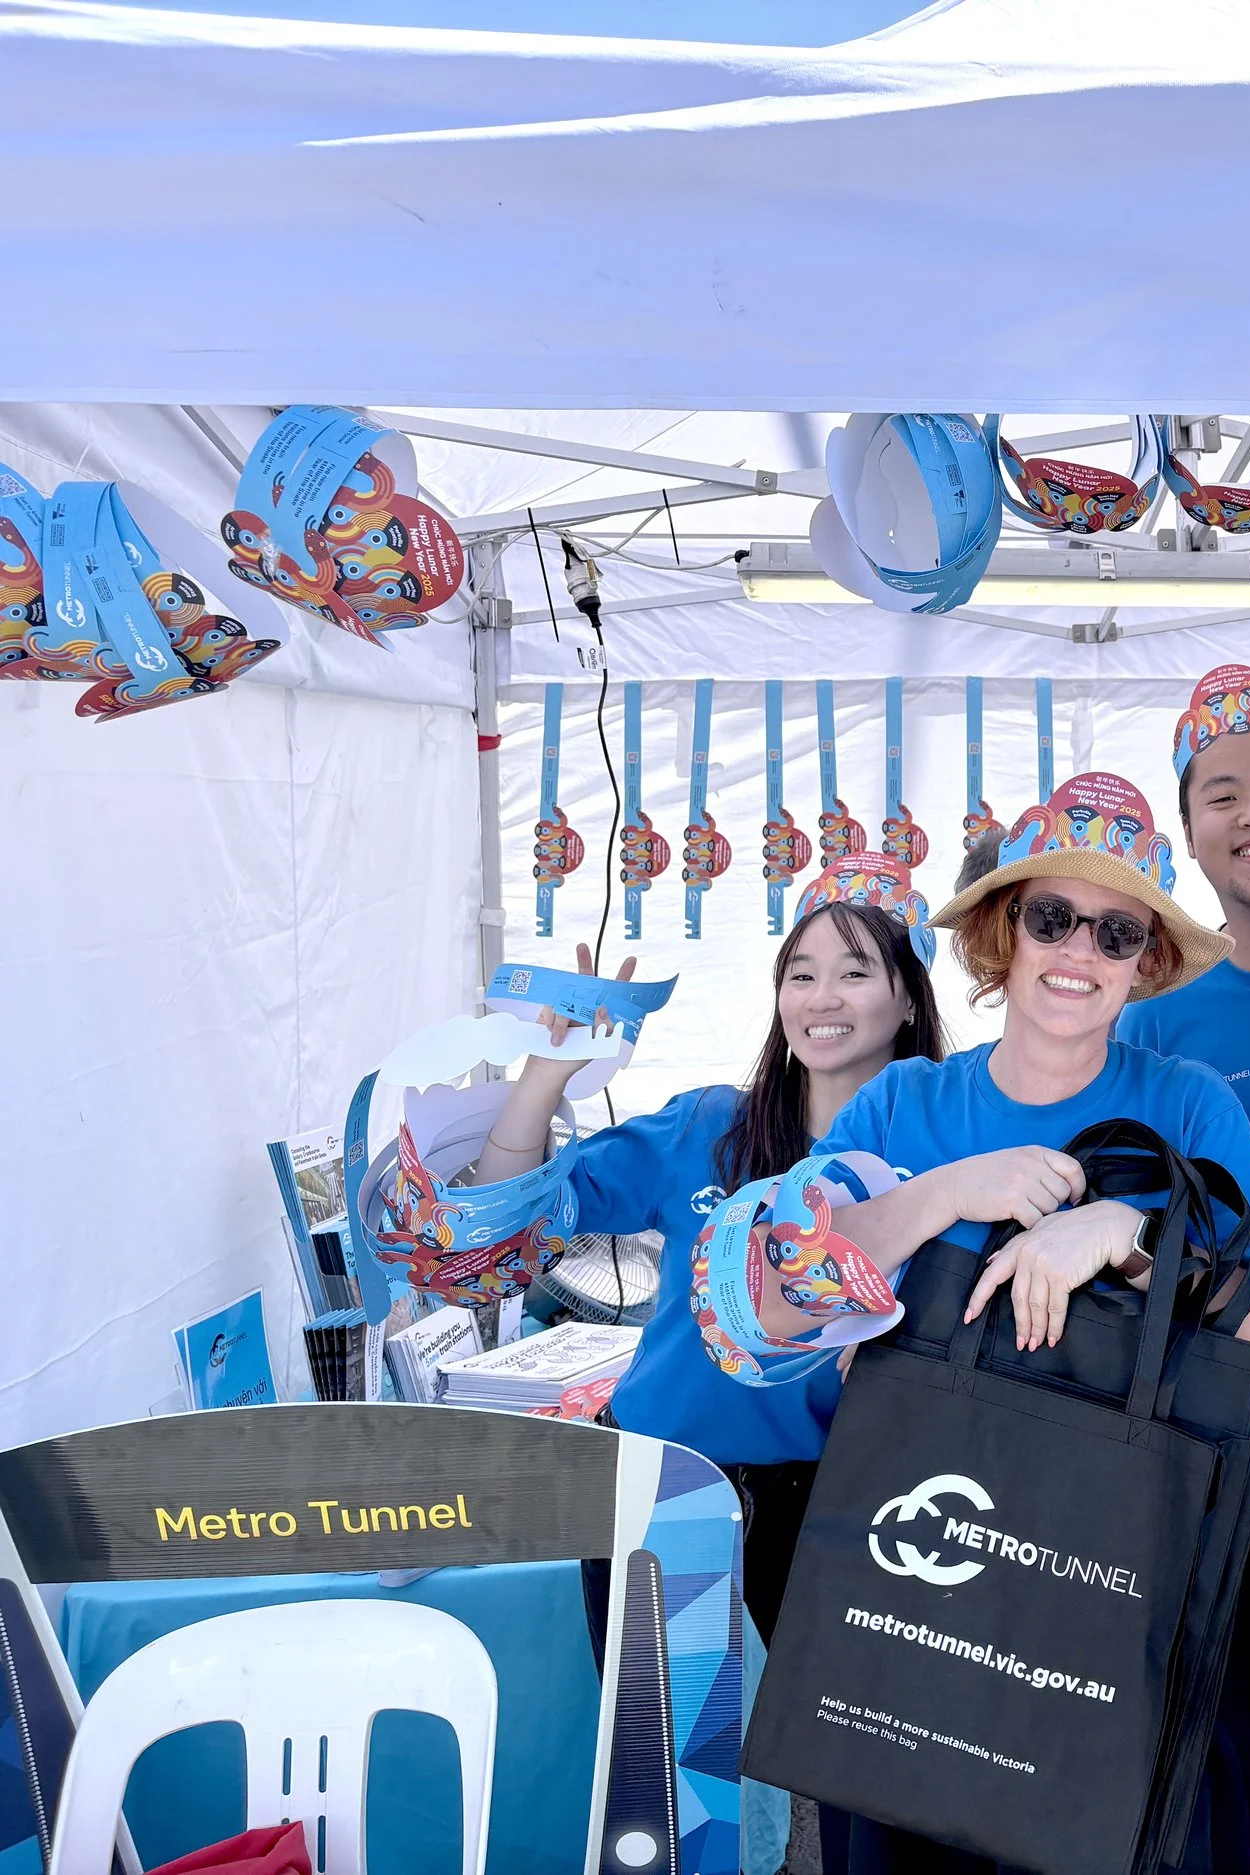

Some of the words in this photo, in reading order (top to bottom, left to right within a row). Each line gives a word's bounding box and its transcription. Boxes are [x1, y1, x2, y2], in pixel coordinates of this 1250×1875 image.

[1042, 465, 1071, 480] Happy
[1072, 477, 1101, 486] Lunar
[1052, 475, 1072, 486] New
[1072, 482, 1095, 491] Year
[418, 515, 431, 547] Happy
[426, 549, 438, 576] Lunar
[409, 528, 420, 550] New
[416, 550, 426, 574] Year
[421, 574, 434, 596] 2025
[1201, 680, 1222, 692] Happy
[1209, 686, 1224, 694] New
[1069, 787, 1098, 800] Happy
[1099, 791, 1125, 803] Lunar
[1077, 796, 1097, 807] New
[1097, 800, 1119, 811] Year
[1119, 805, 1142, 817] 2025
[490, 1246, 511, 1262] 2025
[840, 1264, 852, 1282] New
[849, 1282, 864, 1301] Year
[845, 1252, 860, 1279] Happy
[858, 1281, 875, 1301] Lunar
[431, 1329, 452, 1353] building
[439, 1340, 453, 1356] train
[453, 1325, 473, 1345] stations
[253, 1377, 268, 1396] với
[154, 1506, 297, 1542] Metro
[308, 1494, 474, 1537] Tunnel
[943, 1516, 1143, 1600] METROTUNNEL
[844, 1605, 1117, 1704] metrotunnel.vic.gov.au
[817, 1709, 849, 1727] Please
[851, 1720, 879, 1736] reuse
[880, 1726, 897, 1743] this
[899, 1734, 918, 1751] bag
[820, 1695, 847, 1714] Help
[849, 1705, 862, 1716] us
[864, 1707, 892, 1726] build
[893, 1718, 900, 1727] a
[902, 1721, 930, 1739] more
[931, 1730, 990, 1761] sustainable
[992, 1752, 1036, 1775] Victoria
